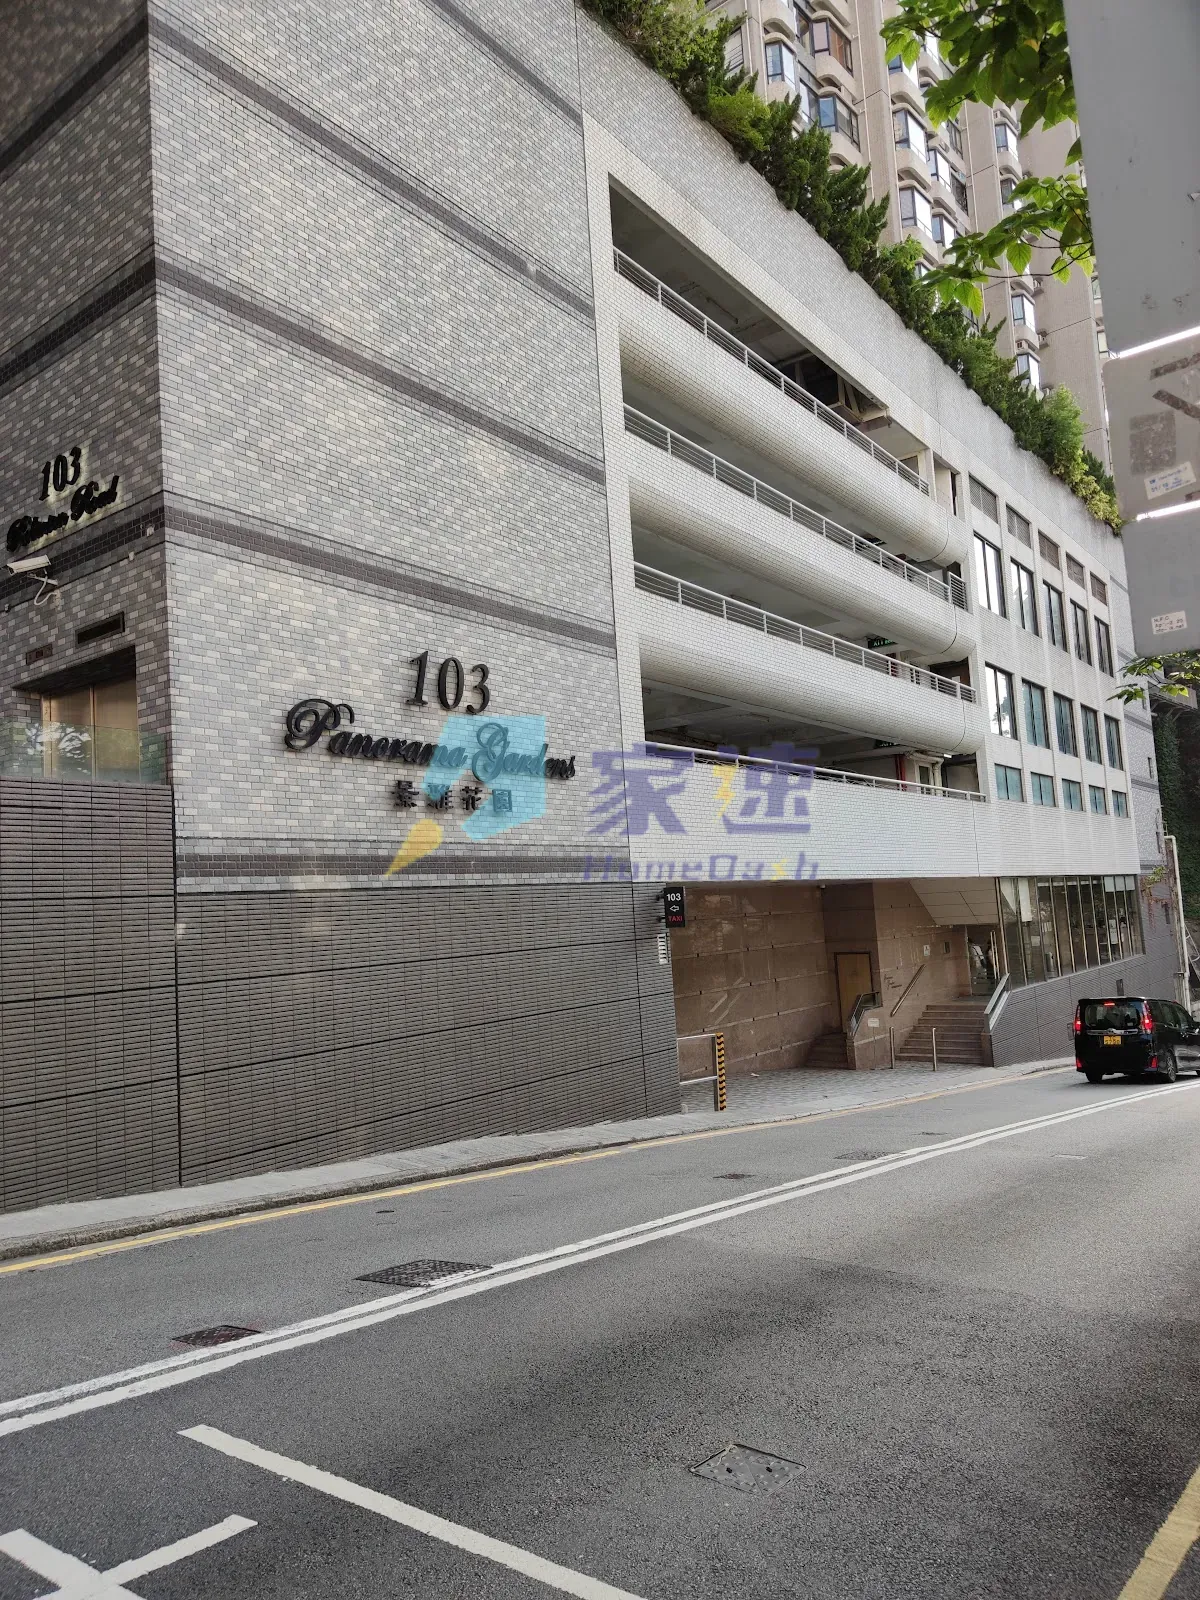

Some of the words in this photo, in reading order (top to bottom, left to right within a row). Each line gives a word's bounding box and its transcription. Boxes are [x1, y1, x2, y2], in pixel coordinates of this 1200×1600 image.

[39, 446, 82, 501] 103
[406, 650, 491, 715] 103
[284, 698, 468, 769] Panorama
[472, 721, 576, 783] Gardens
[666, 893, 681, 902] 103
